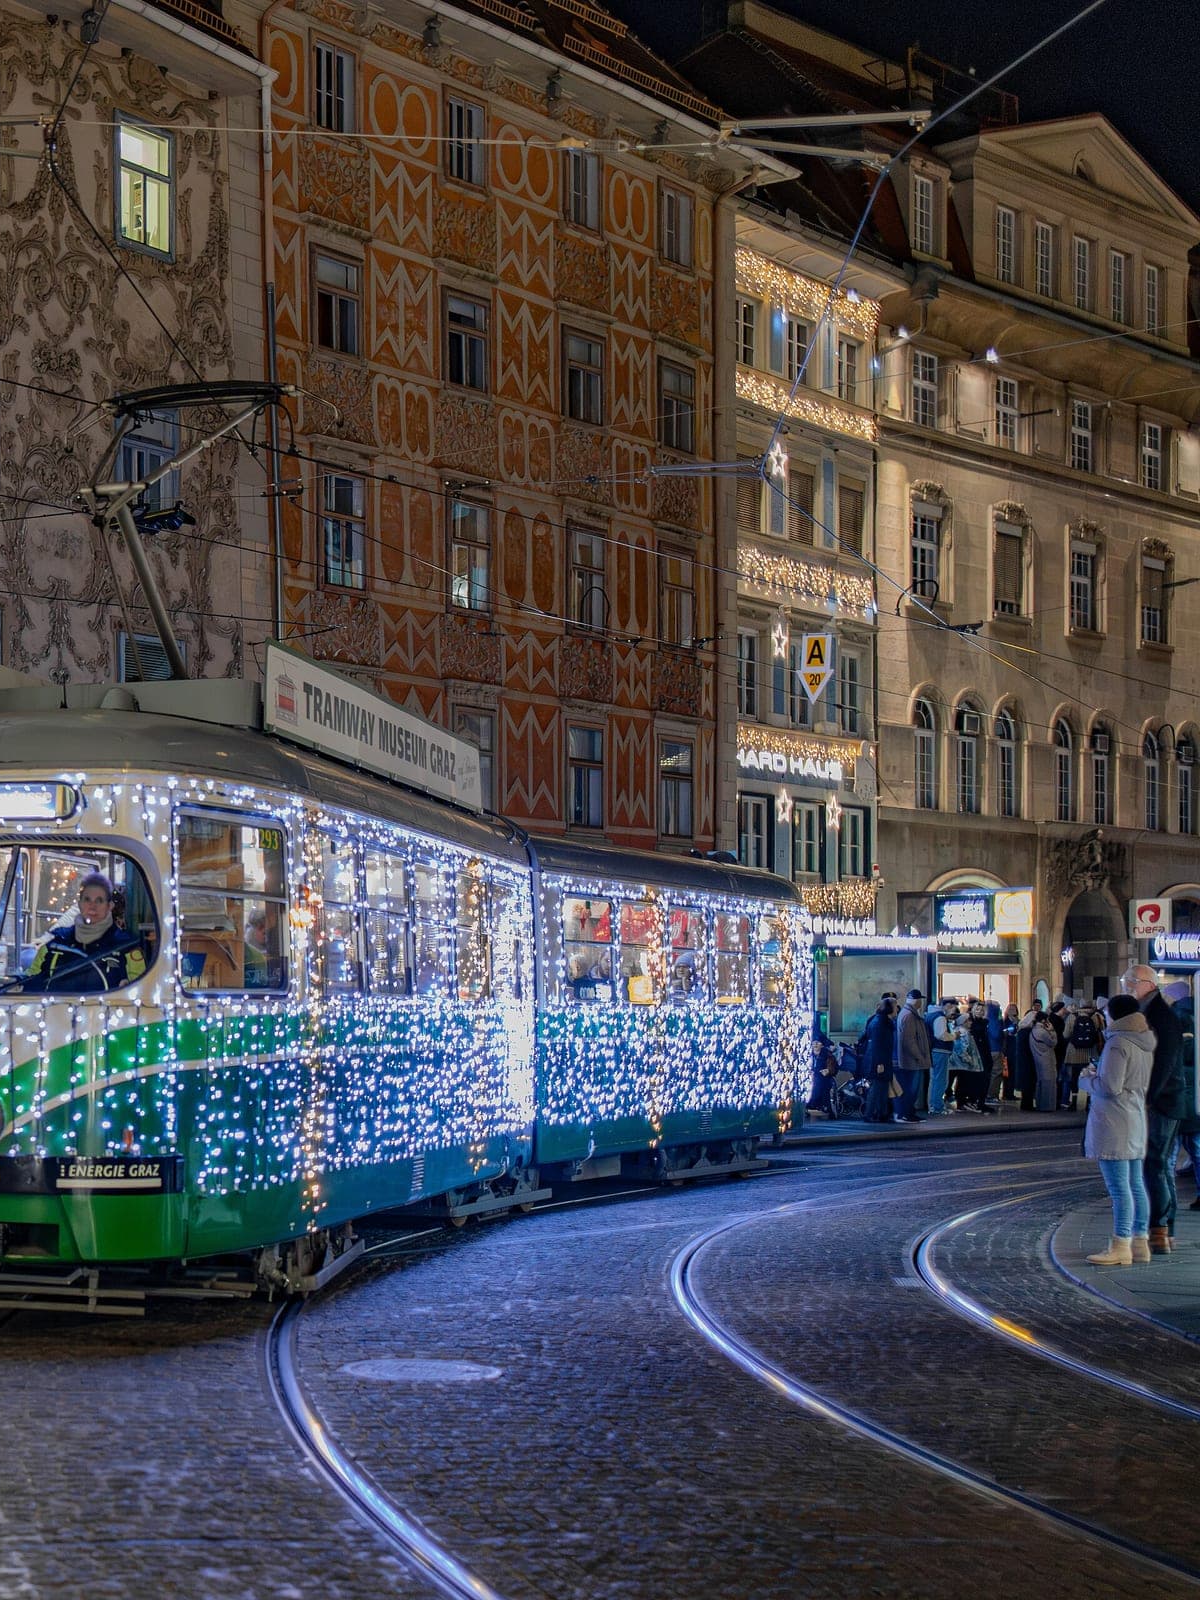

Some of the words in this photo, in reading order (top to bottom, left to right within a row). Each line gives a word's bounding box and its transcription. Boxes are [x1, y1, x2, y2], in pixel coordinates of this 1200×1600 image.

[807, 639, 825, 665] A
[809, 673, 821, 686] 20
[302, 681, 376, 747] TRAMWAY
[378, 717, 428, 771] MUSEUM
[429, 742, 456, 782] GRAZ
[789, 755, 843, 782] HAUS
[259, 828, 279, 850] 293
[68, 1164, 126, 1177] ENERGIE
[128, 1163, 161, 1177] GRAZ
